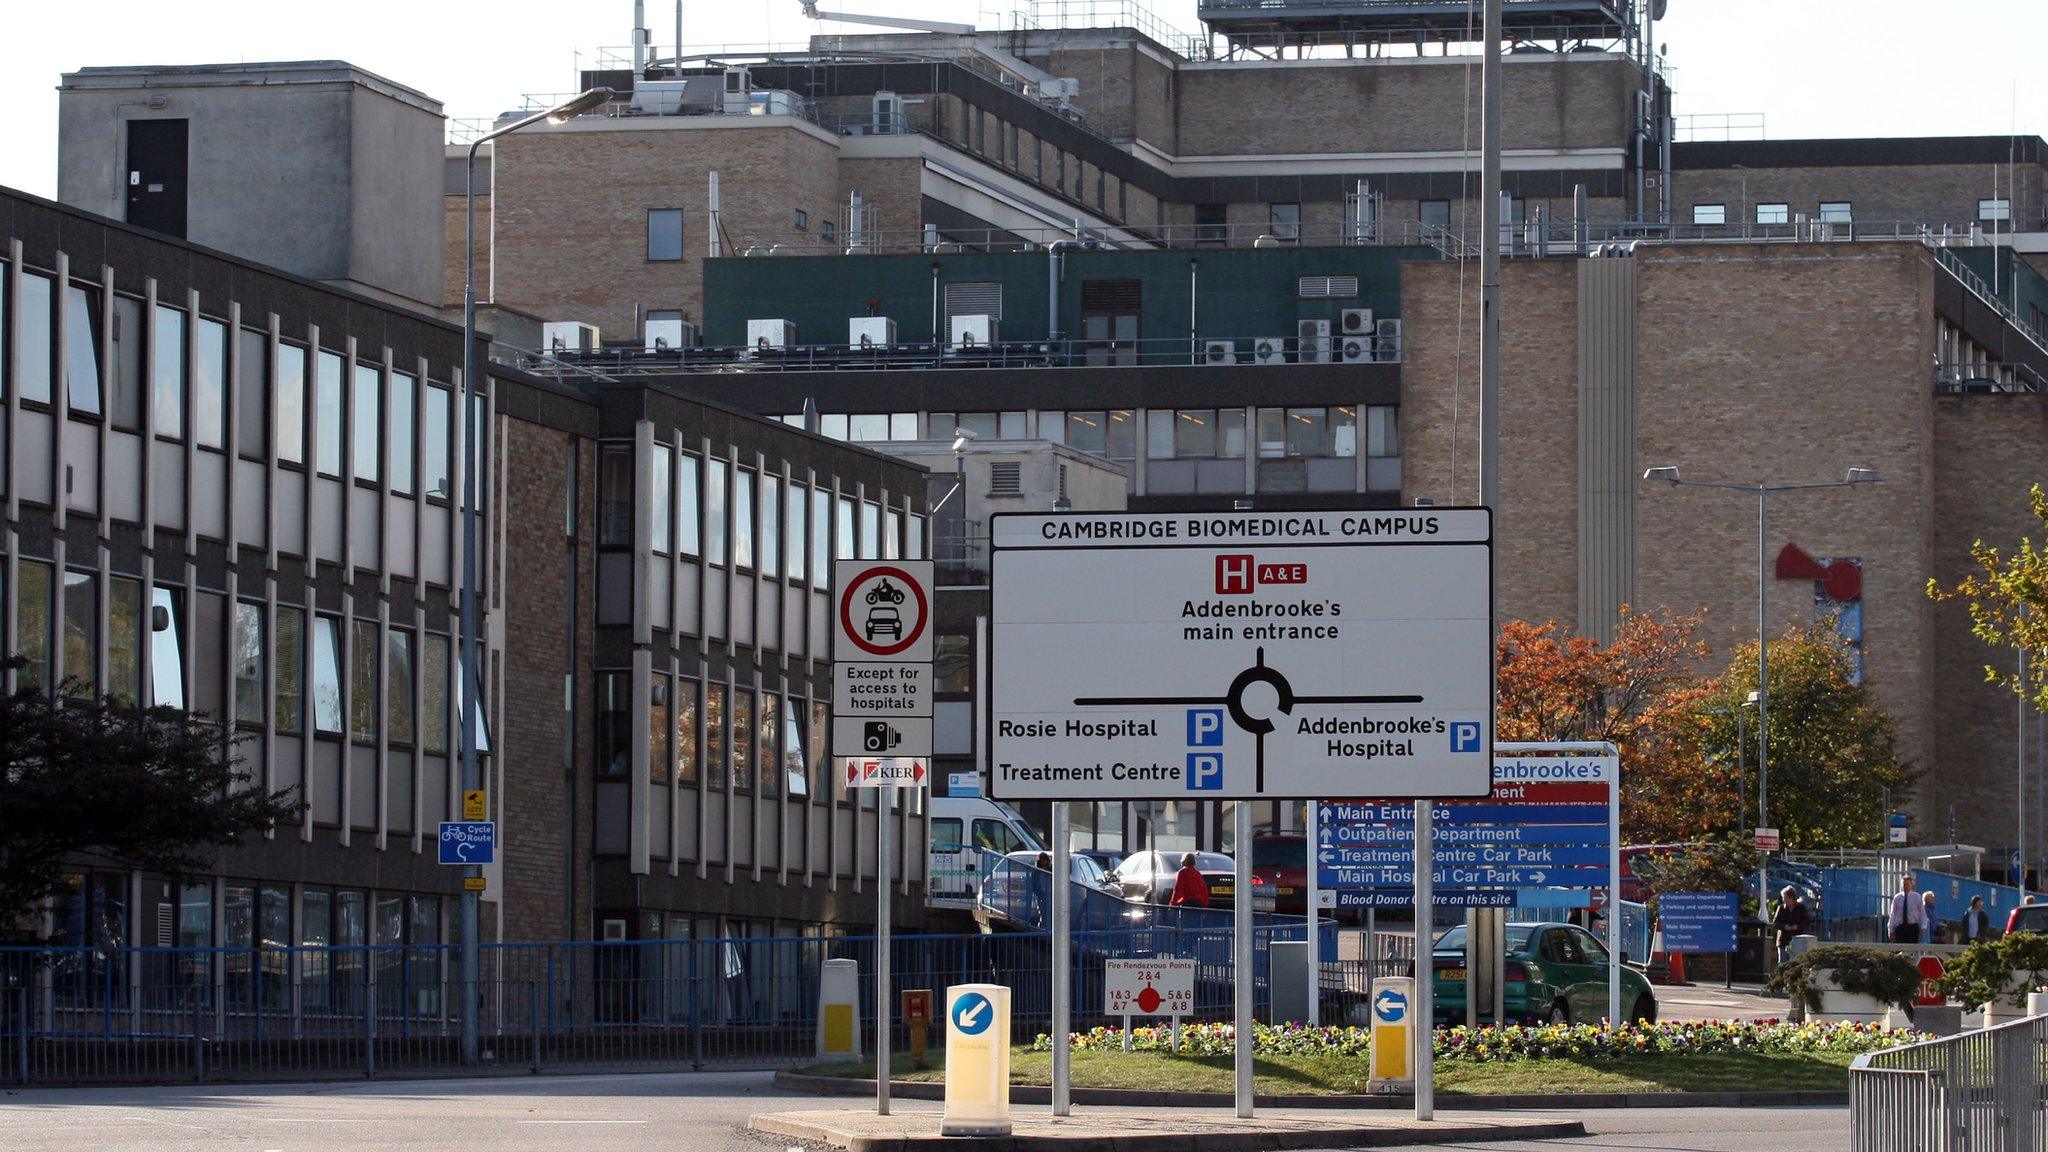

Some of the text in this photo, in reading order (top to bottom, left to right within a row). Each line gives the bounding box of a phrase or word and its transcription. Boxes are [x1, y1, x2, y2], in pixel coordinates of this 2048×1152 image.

[1042, 518, 1438, 539] CAMBRIDGE BIOMEDICAL CAMPUS
[1223, 560, 1246, 589] H
[1182, 600, 1340, 617] Addenbrooke's
[1184, 623, 1338, 639] main entrance
[848, 667, 918, 681] Except for
[850, 683, 916, 693] access to
[851, 697, 914, 710] hospitals
[1000, 713, 1218, 743] Rosie Hospital P
[1298, 717, 1476, 750] Addenbrooke's P
[1328, 739, 1413, 759] Hospital
[881, 766, 914, 778] KIER
[999, 757, 1218, 787] Treatment Centre P
[1493, 760, 1602, 779] enbrooke's
[1338, 807, 1450, 820] Main Entrce
[467, 825, 491, 835] Cycle
[1338, 827, 1419, 844] Outpatien
[467, 834, 492, 842] Route
[1432, 849, 1477, 862] entre
[1483, 849, 1509, 862] Car
[1517, 849, 1552, 862] Park
[1338, 869, 1521, 885] Main Hosal Car Park
[1340, 894, 1374, 905] Blood
[1375, 894, 1408, 905] Donor
[1450, 896, 1463, 905] on
[1466, 894, 1488, 905] this
[1489, 894, 1511, 905] site
[1137, 971, 1161, 980] 2 & 4
[1109, 990, 1131, 1000] 1 & 3
[1167, 990, 1192, 1000] 5 & 6
[1112, 1002, 1127, 1011] & 7
[1171, 1002, 1187, 1011] & 8
